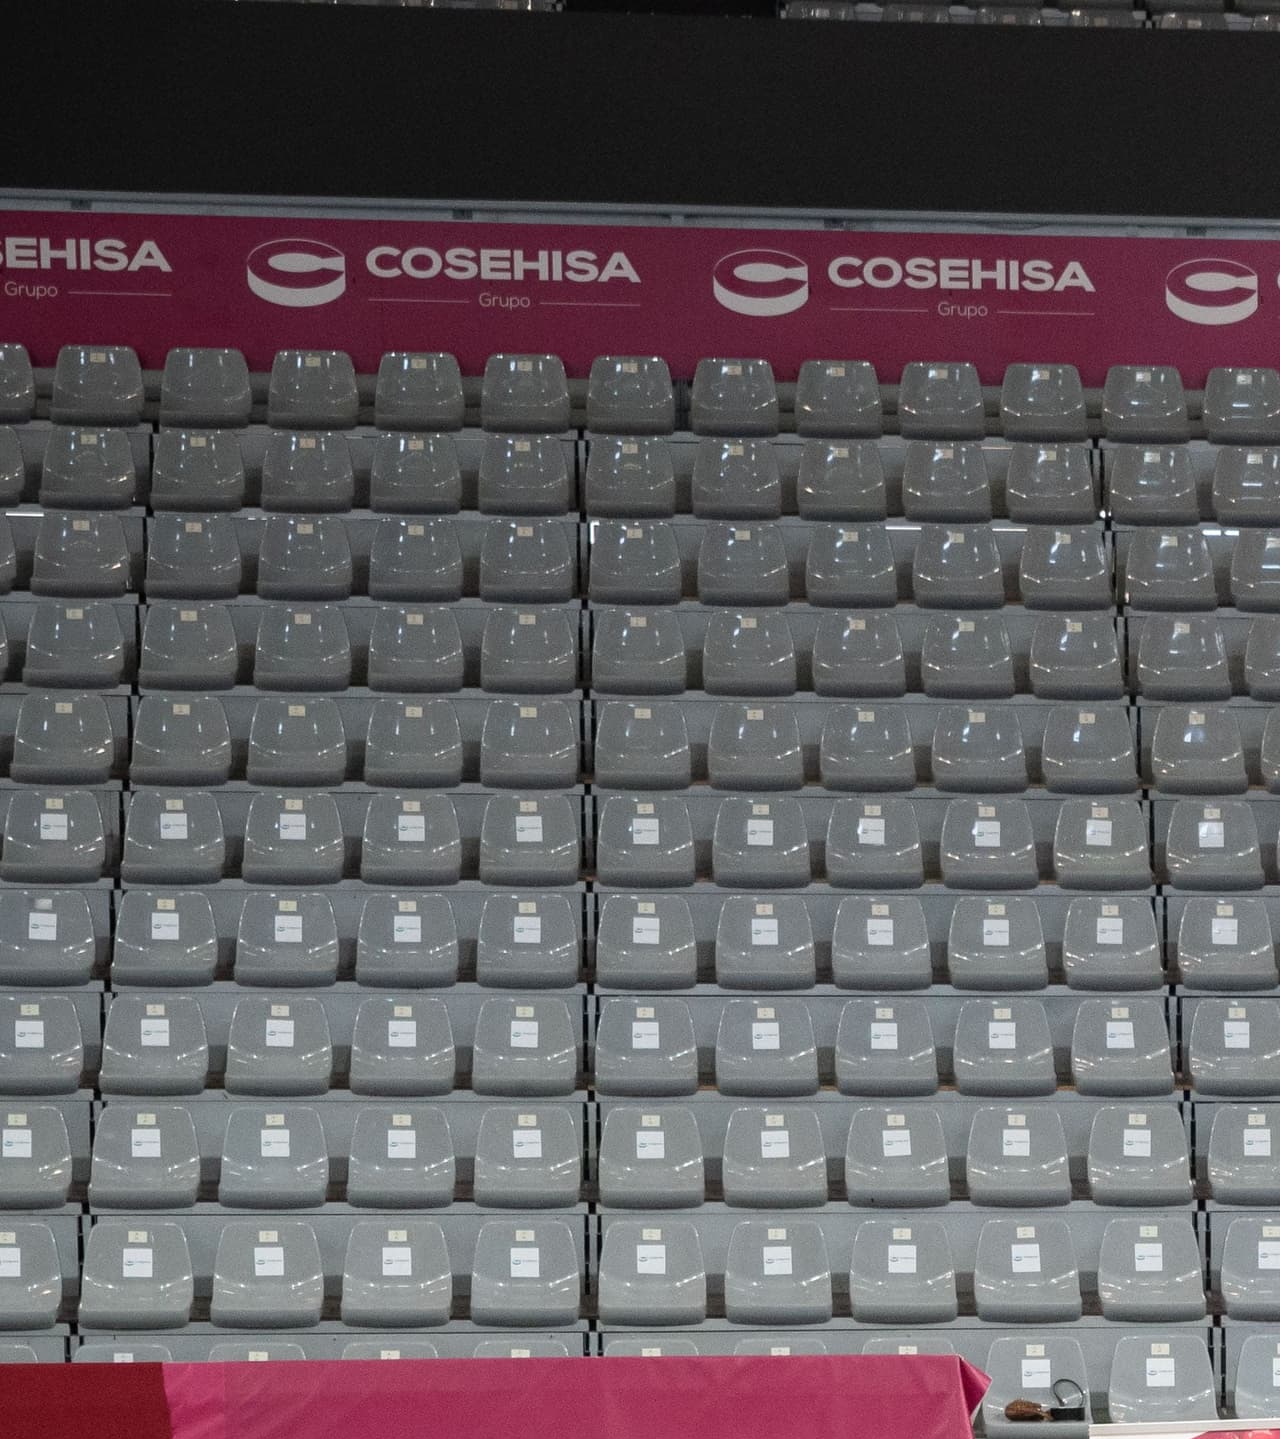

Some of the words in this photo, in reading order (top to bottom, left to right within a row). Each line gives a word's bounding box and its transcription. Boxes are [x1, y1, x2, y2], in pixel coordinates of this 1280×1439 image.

[366, 246, 641, 283] COSEHISA
[828, 256, 1096, 293] COSEHISA
[4, 281, 58, 300] Grupo
[478, 292, 531, 310] Grupo
[937, 301, 988, 320] Grupo
